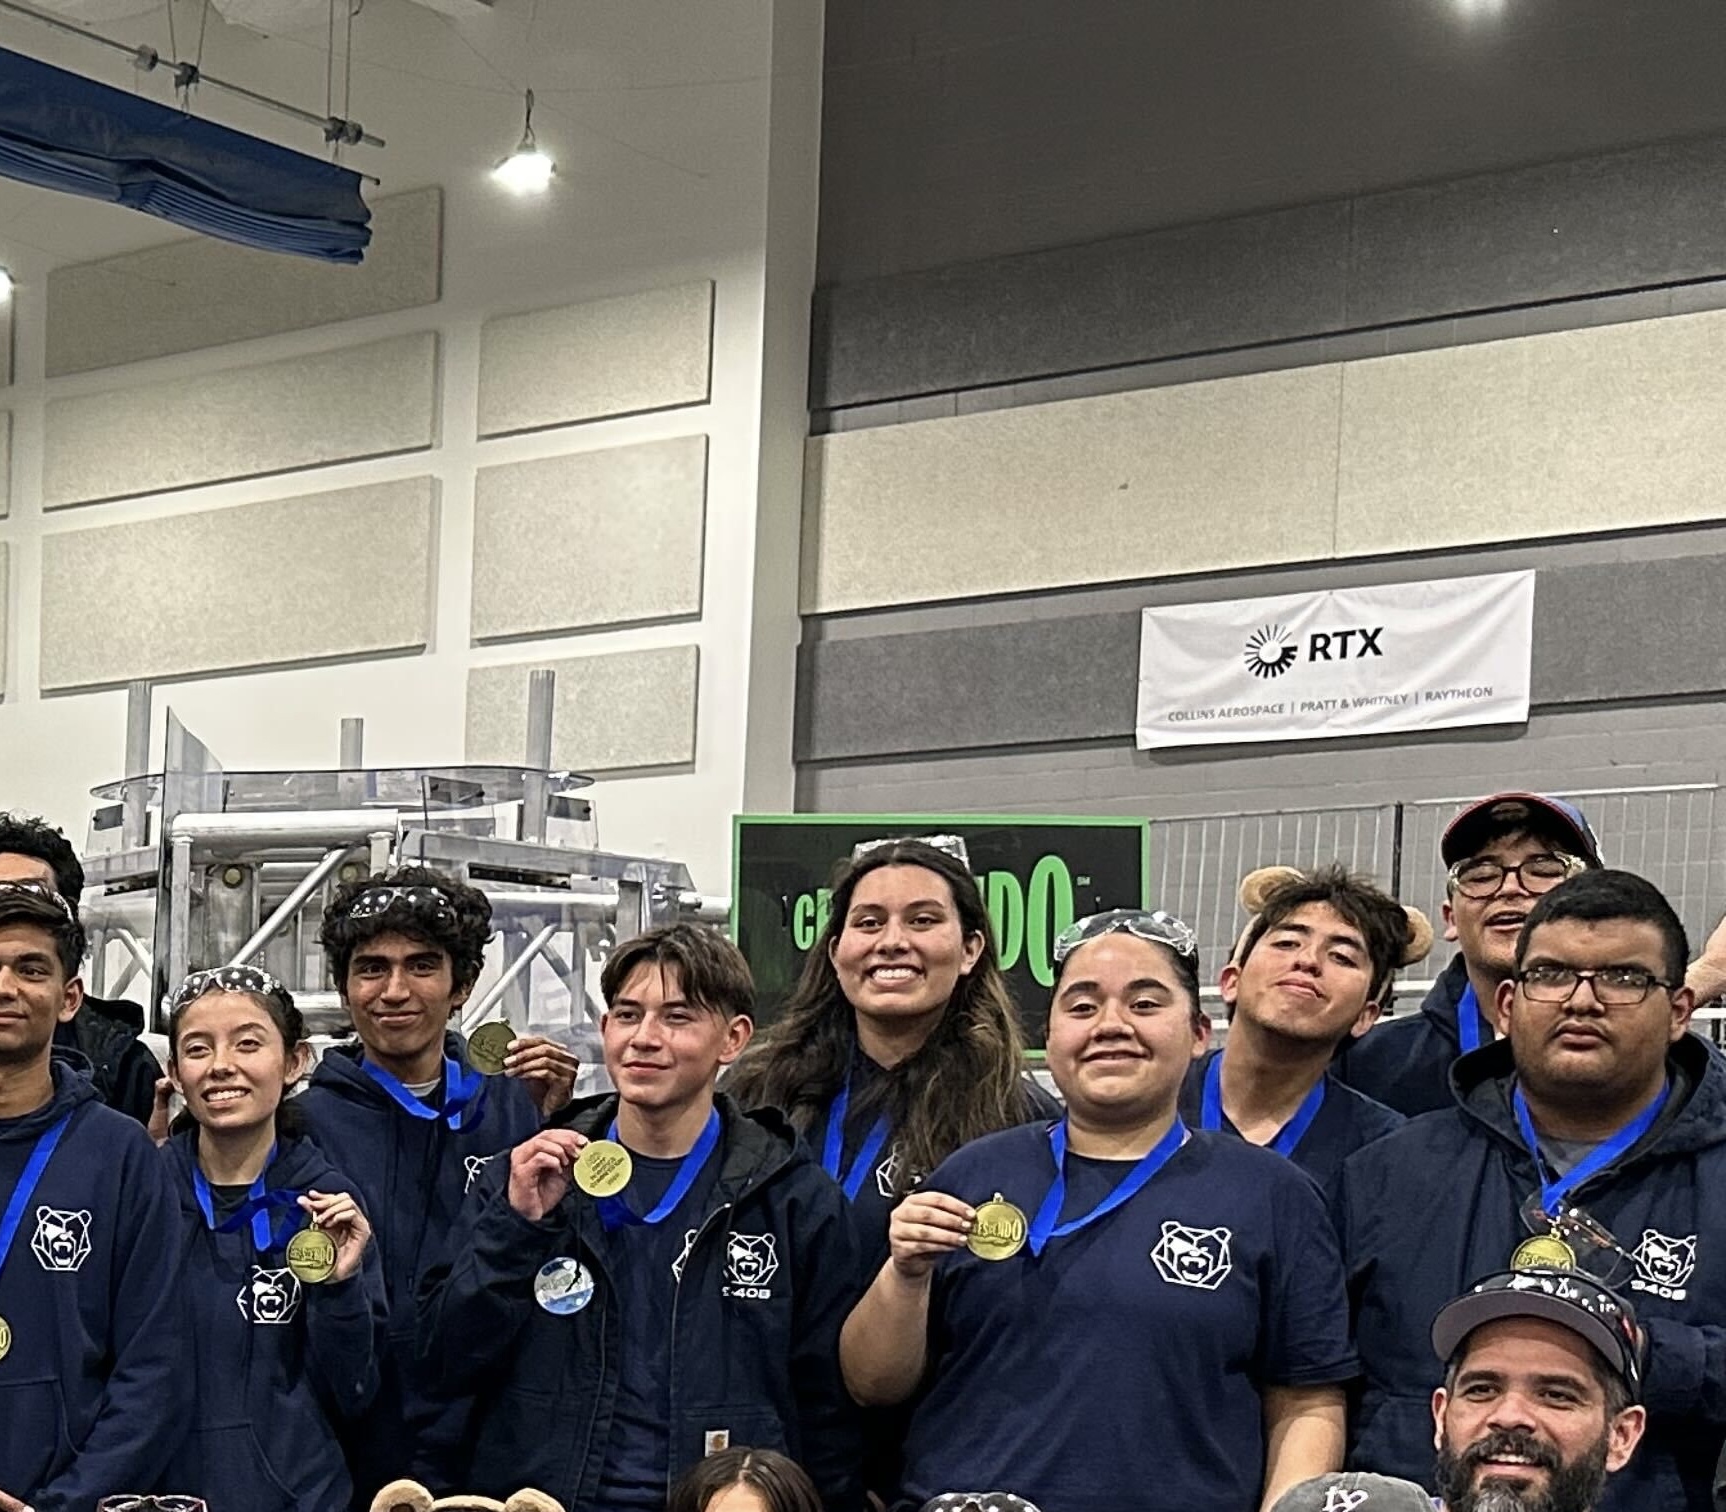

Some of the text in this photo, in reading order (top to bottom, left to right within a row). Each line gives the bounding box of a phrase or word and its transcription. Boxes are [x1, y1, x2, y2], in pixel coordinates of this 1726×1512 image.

[1309, 627, 1384, 662] RTX
[1168, 686, 1494, 723] COLLINS AEROSPACE PRATT & WHITNEY RAYTHEON
